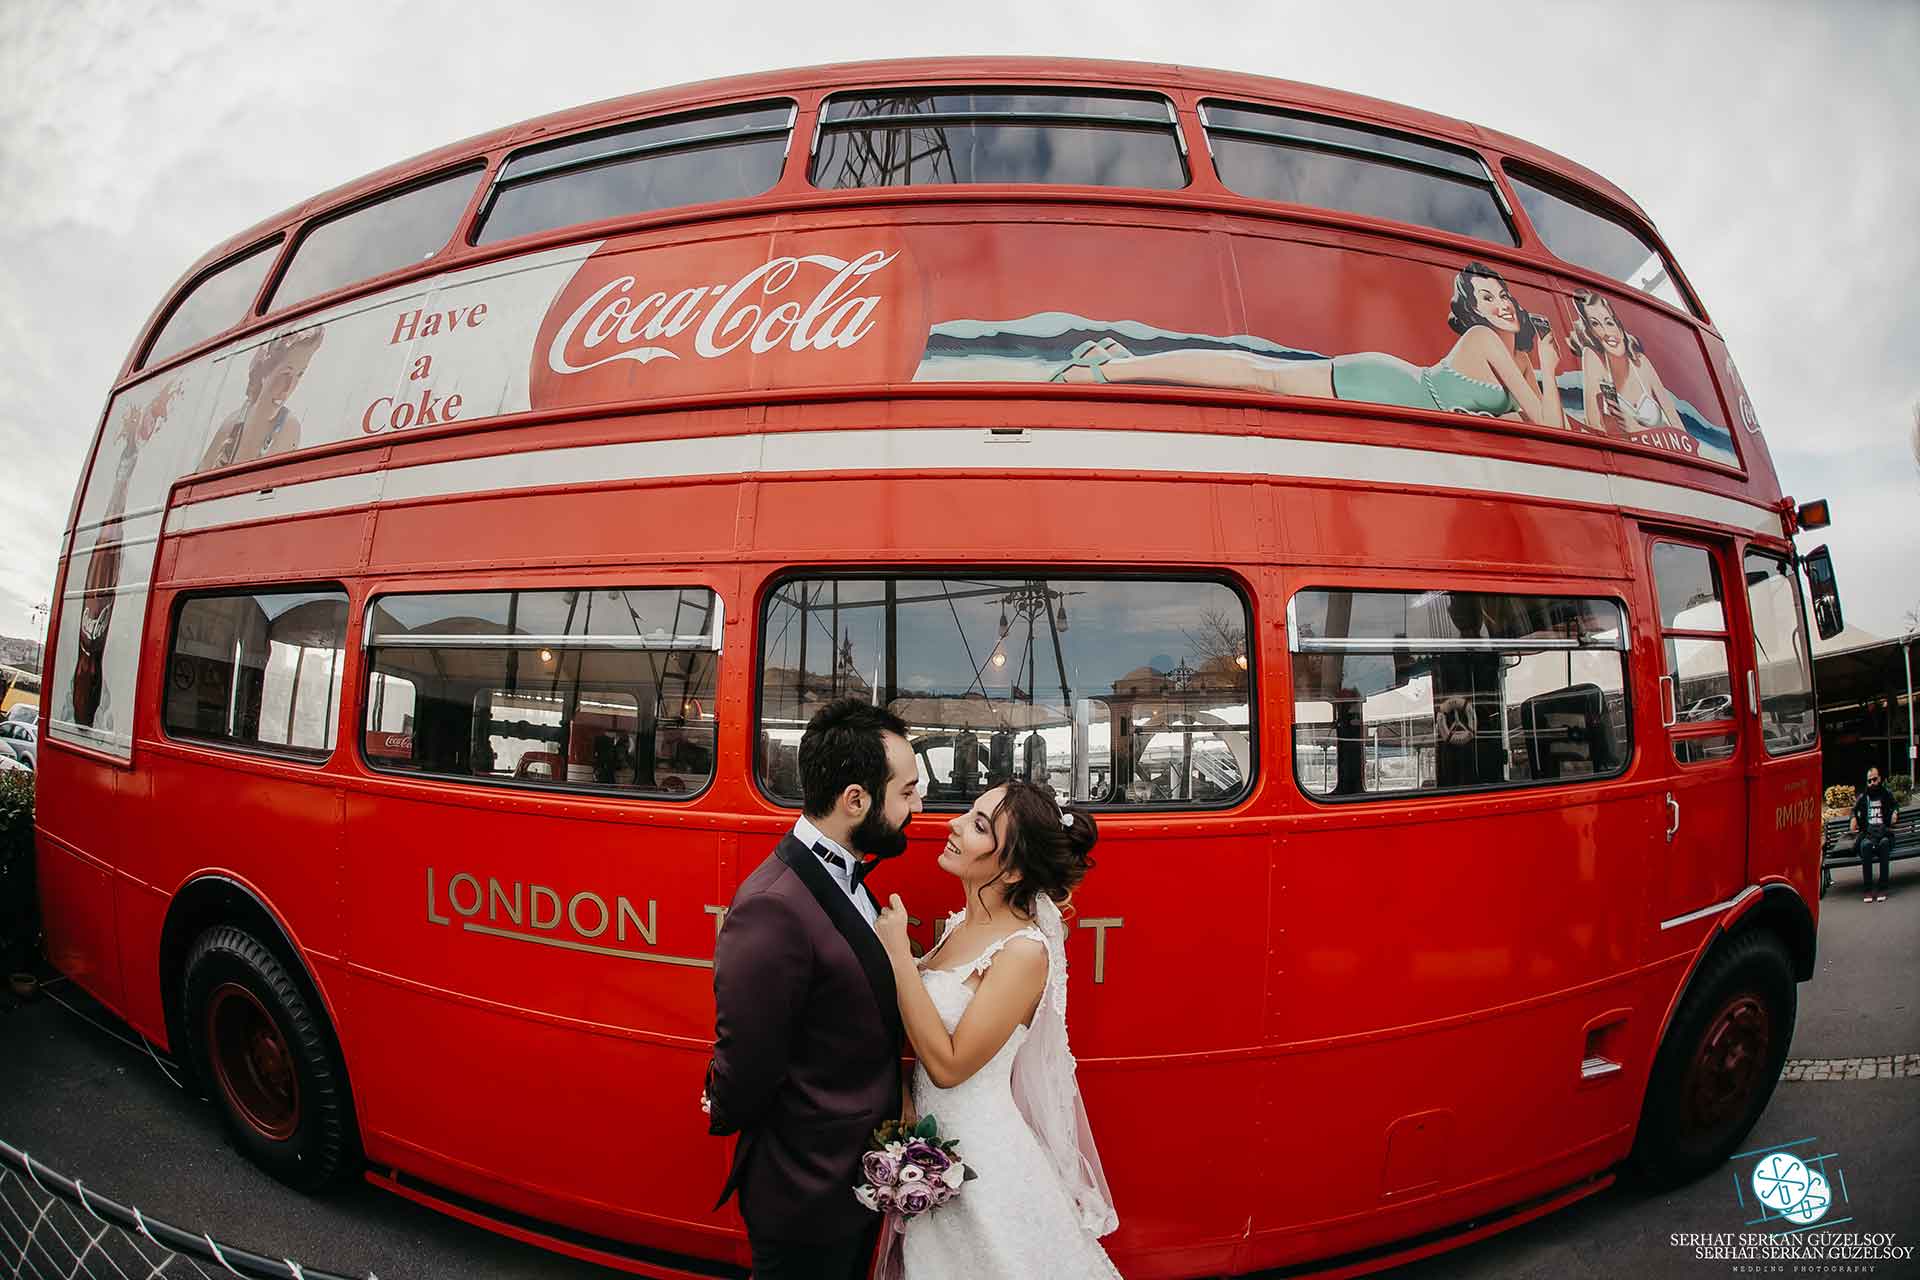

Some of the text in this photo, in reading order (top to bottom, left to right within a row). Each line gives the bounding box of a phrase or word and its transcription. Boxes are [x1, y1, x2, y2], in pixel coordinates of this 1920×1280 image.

[386, 303, 488, 345] Have
[549, 249, 901, 374] Coca-Cola
[410, 354, 432, 381] a
[362, 389, 463, 434] Coke
[427, 867, 657, 945] LONDON
